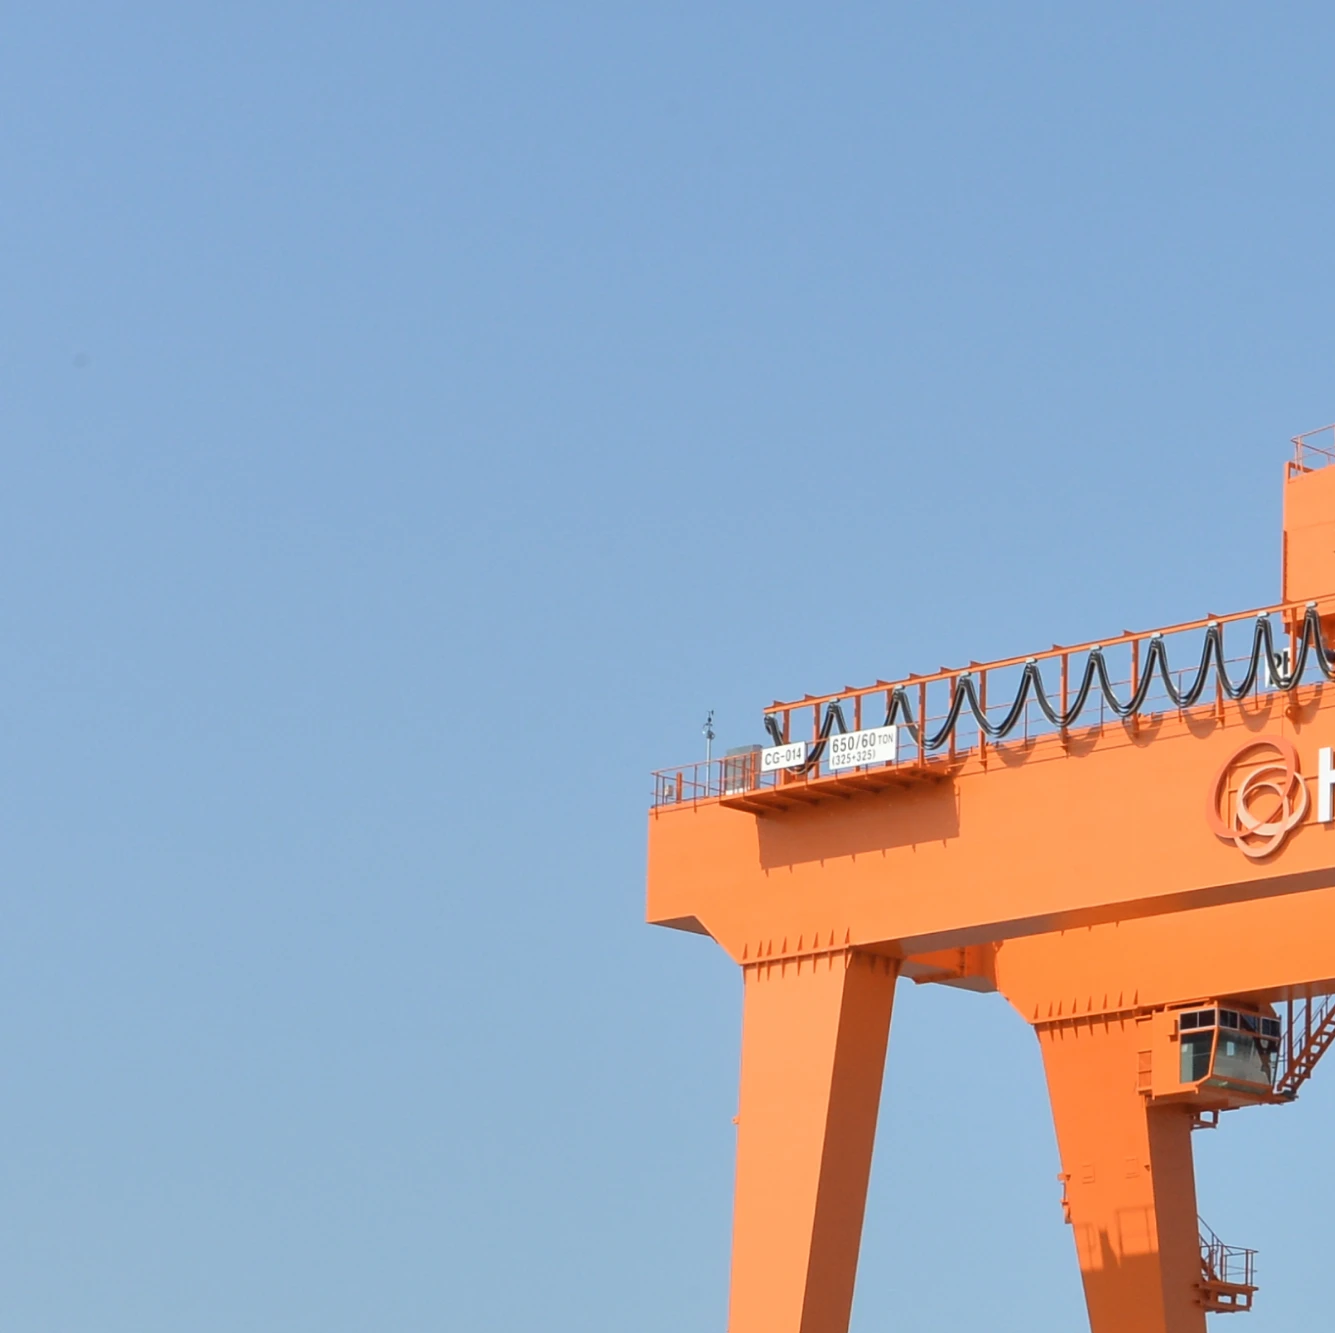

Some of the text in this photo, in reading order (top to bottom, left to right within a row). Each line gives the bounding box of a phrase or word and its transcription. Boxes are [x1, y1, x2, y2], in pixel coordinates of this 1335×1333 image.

[832, 732, 893, 753] 650/60 TON
[765, 747, 802, 765] CG-014
[832, 749, 875, 766] (325+325)
